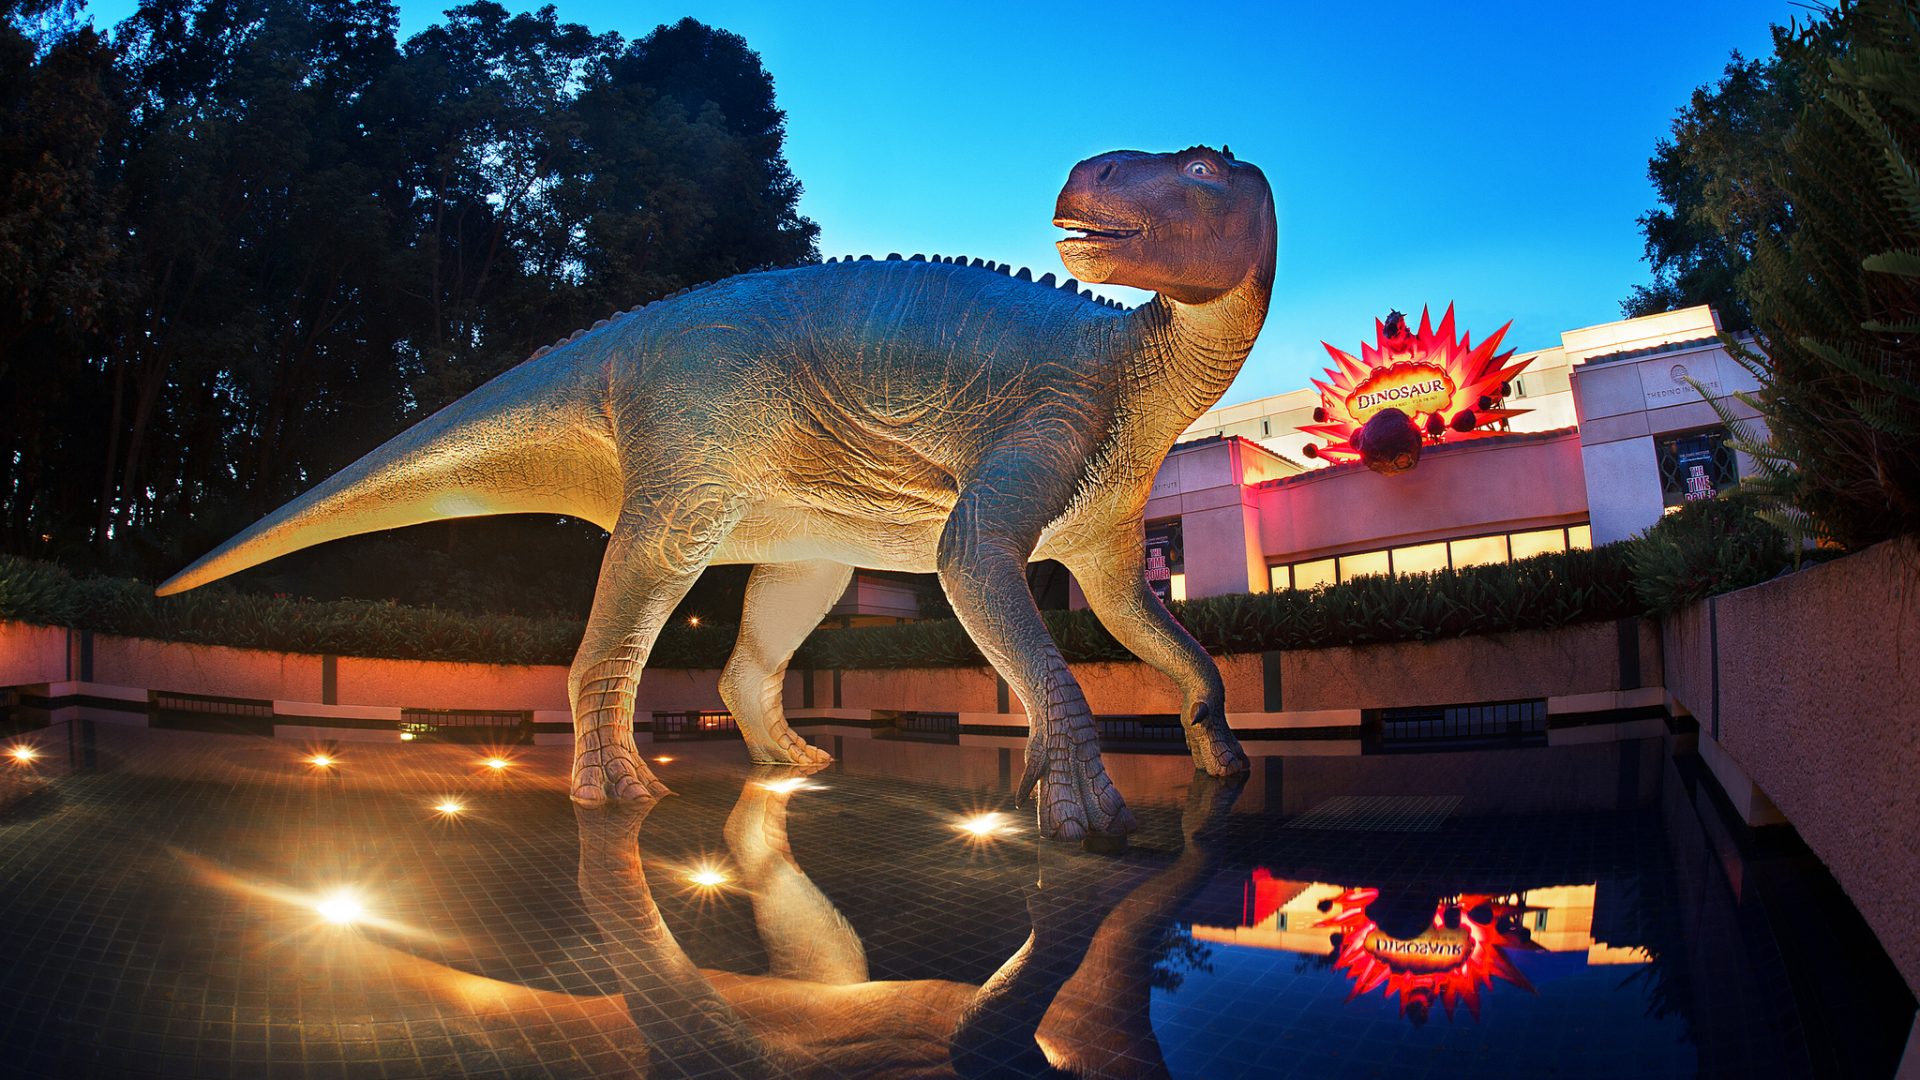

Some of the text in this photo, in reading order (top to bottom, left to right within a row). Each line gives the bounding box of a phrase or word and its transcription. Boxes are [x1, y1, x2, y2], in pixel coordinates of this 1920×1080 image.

[1683, 382, 1719, 392] INSTUTE
[1356, 380, 1445, 409] DINOSAUR
[1689, 465, 1704, 477] THE
[1686, 475, 1711, 493] TIME
[1150, 547, 1162, 557] THE
[1146, 555, 1166, 569] TIME
[1144, 566, 1171, 581] ROVER
